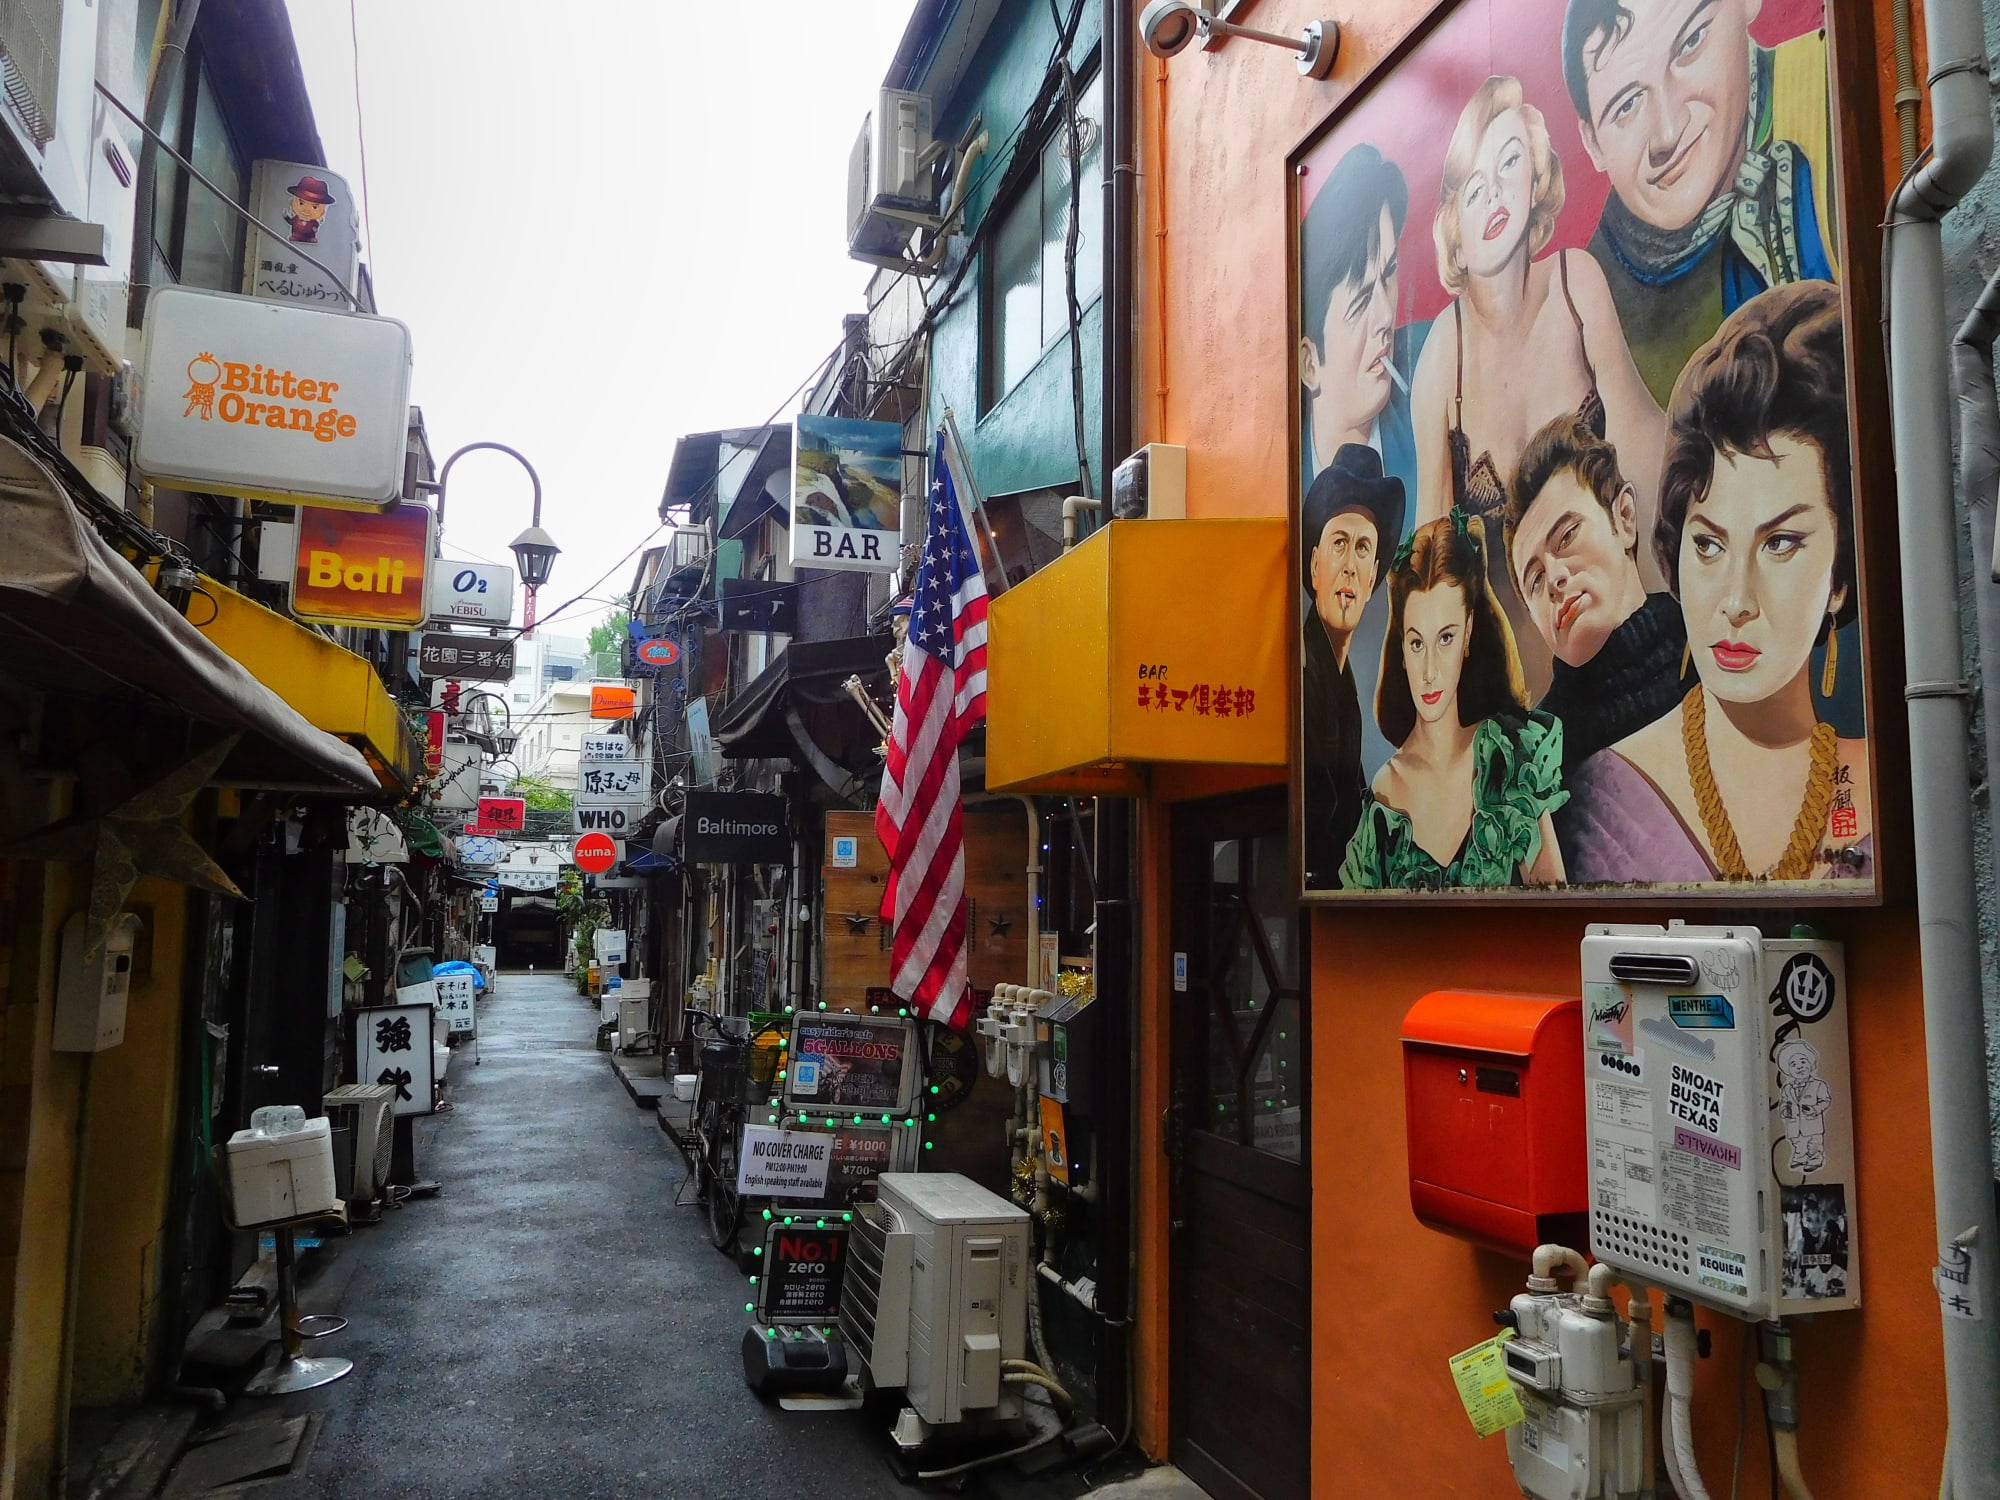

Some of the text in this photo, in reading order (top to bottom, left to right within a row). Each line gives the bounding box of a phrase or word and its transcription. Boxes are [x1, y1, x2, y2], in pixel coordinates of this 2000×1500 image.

[221, 362, 339, 404] Bitter
[219, 393, 357, 442] Orange
[813, 530, 881, 561] BAR
[308, 550, 405, 594] Bali
[450, 605, 487, 616] YEBISU
[423, 646, 512, 669] 花園三番街
[1138, 664, 1168, 680] BAR
[578, 810, 626, 829] WHO
[697, 817, 779, 837] Baltimore
[803, 1038, 899, 1060] 5GALLONS
[1671, 1065, 1723, 1097] SMOAT
[1671, 1082, 1720, 1116] BUSTA
[1669, 1099, 1718, 1133] TEXAS
[753, 1141, 765, 1156] NO
[767, 1142, 792, 1159] COVER
[794, 1144, 824, 1160] CHARGE
[849, 1139, 886, 1152] ¥1000
[1678, 1133, 1736, 1164] HKWALLS
[745, 1174, 822, 1188] English speaking staff available
[780, 1237, 838, 1262] No.1
[788, 1262, 825, 1274] zero
[1700, 1257, 1743, 1278] REQUIEM
